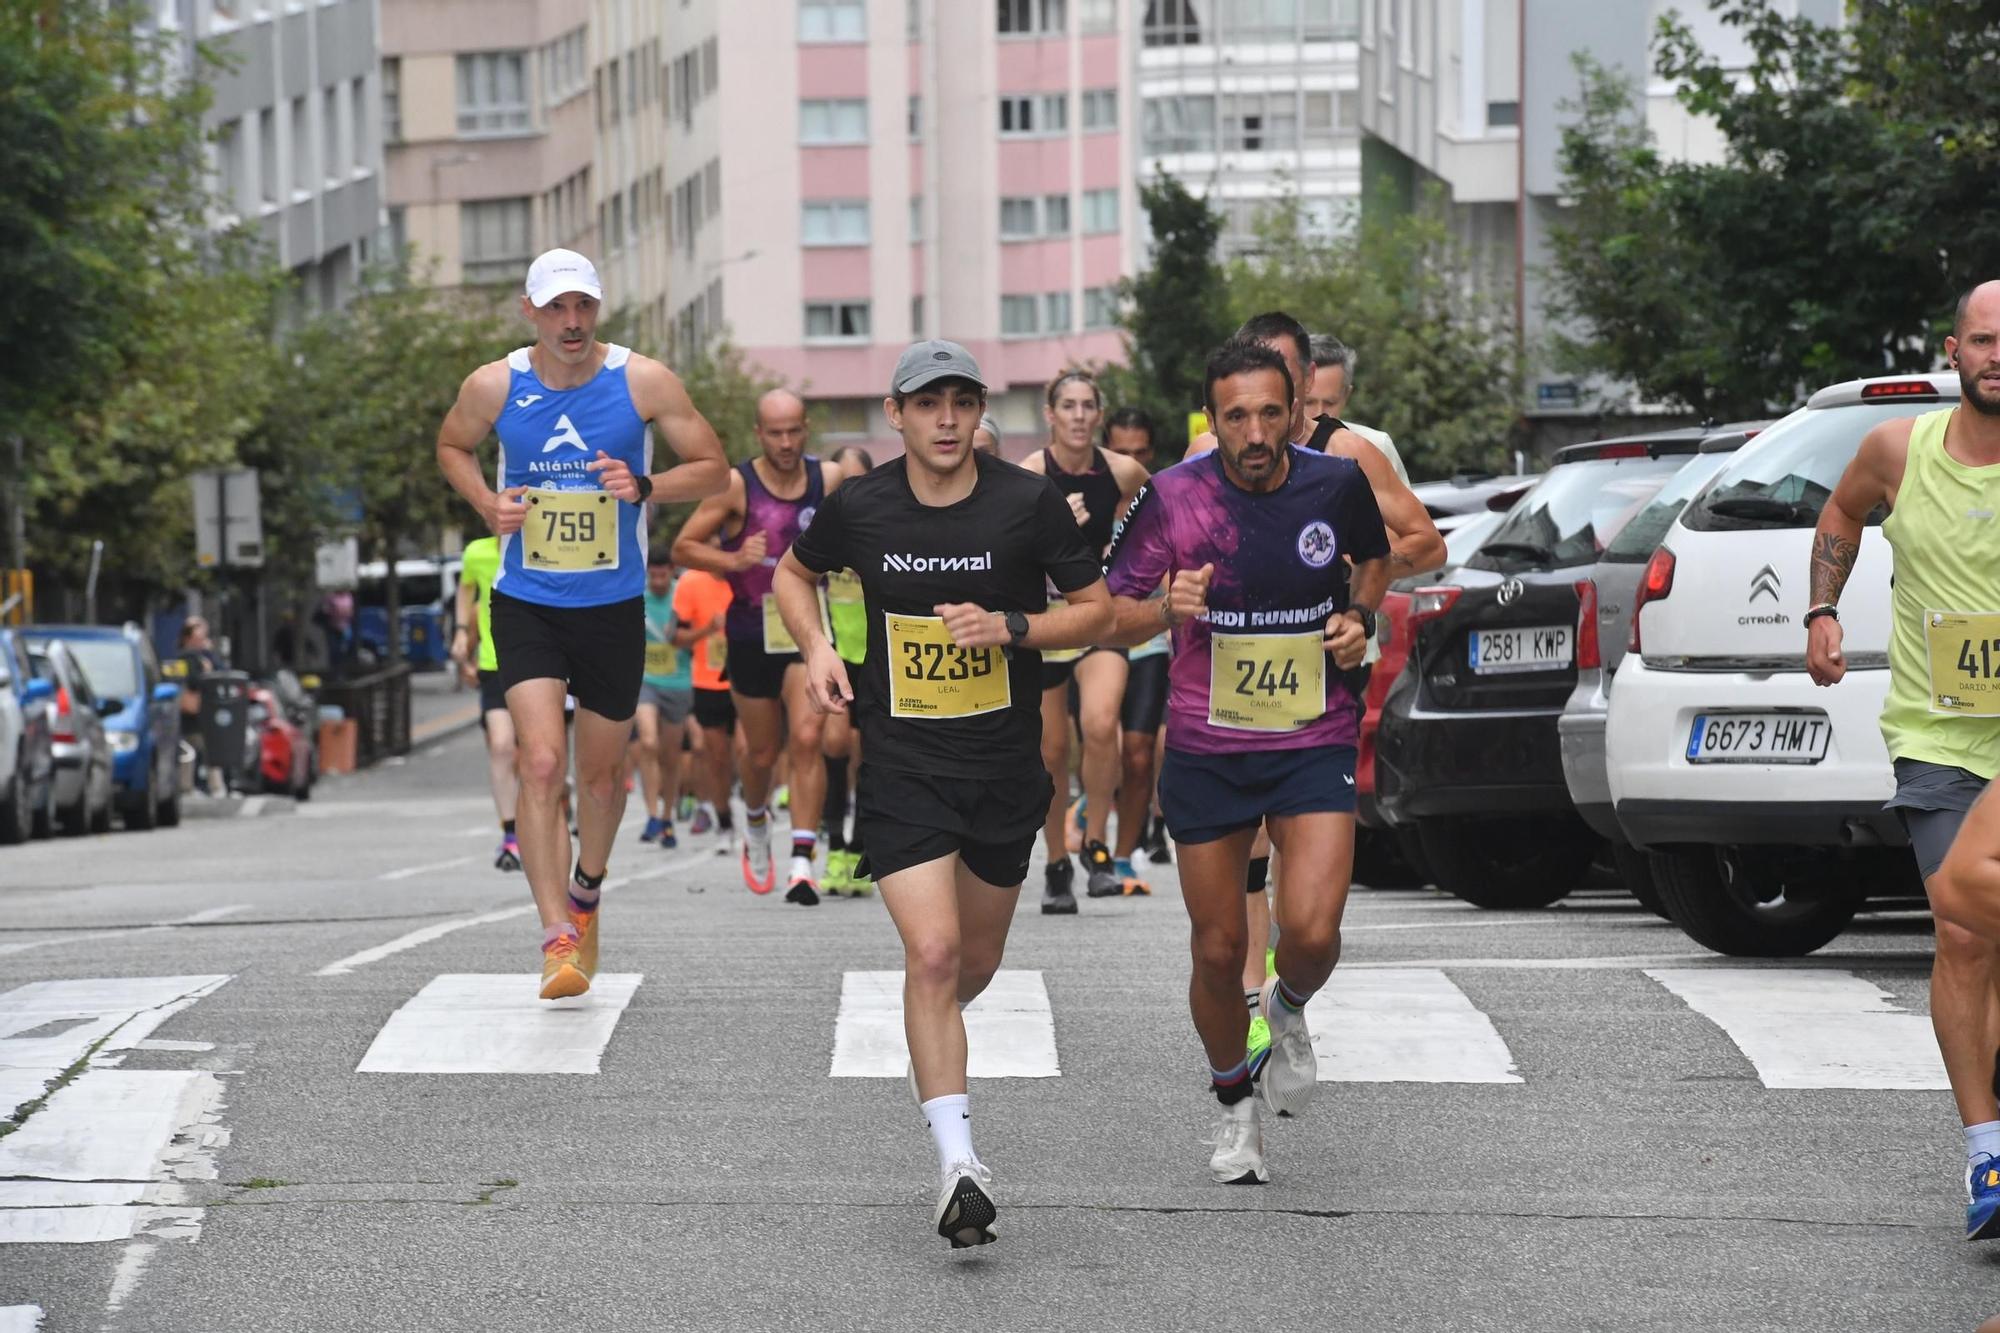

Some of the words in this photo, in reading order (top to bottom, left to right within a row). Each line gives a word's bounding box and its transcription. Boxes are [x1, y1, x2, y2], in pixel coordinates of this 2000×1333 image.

[529, 460, 593, 472] Atlánti
[542, 511, 595, 542] 759
[1251, 596, 1333, 626] RUNNERS
[1483, 632, 1521, 661] 2581
[1534, 629, 1566, 660] KWP
[903, 641, 992, 681] 3239
[938, 685, 960, 694] LEAL
[1235, 658, 1299, 697] 244
[1249, 699, 1282, 709] CARLOS
[1704, 720, 1765, 751] 6673
[1771, 720, 1824, 752] HMT
